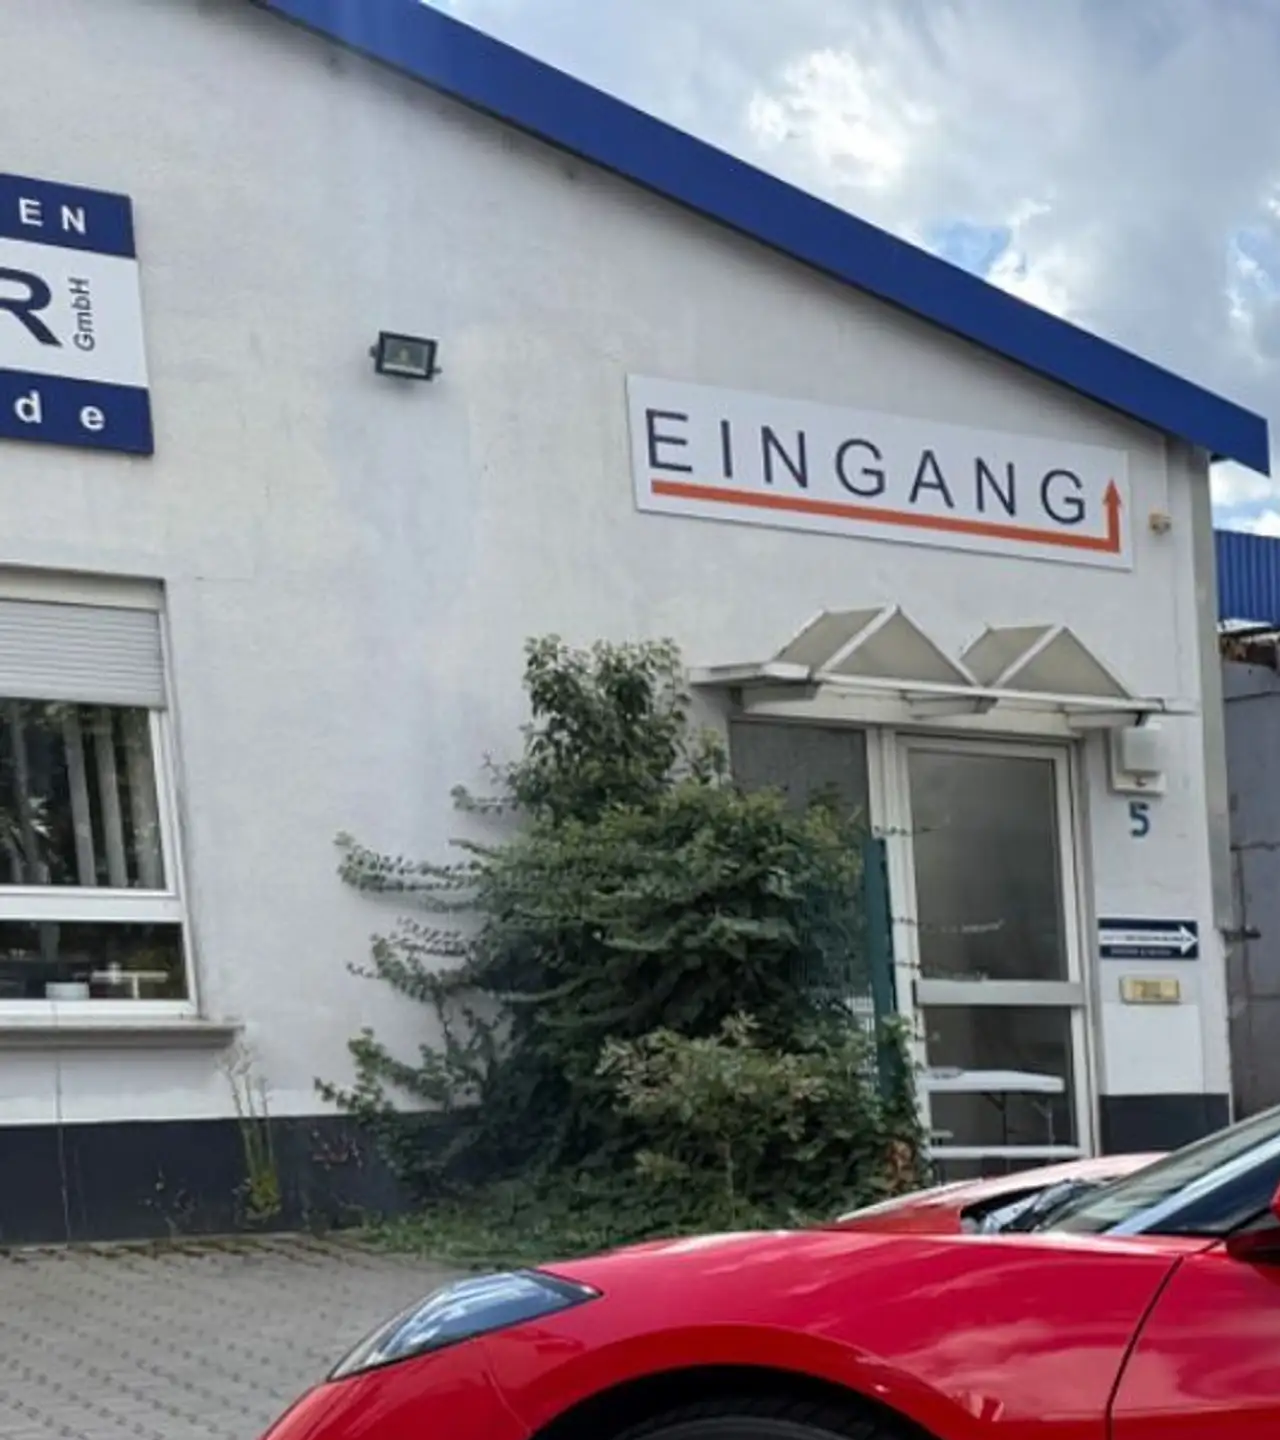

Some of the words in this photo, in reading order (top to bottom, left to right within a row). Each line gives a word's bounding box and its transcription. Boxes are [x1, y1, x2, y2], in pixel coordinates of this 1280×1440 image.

[67, 276, 96, 352] GmbH
[645, 408, 1085, 524] EINGANG
[1128, 801, 1150, 838] 5
